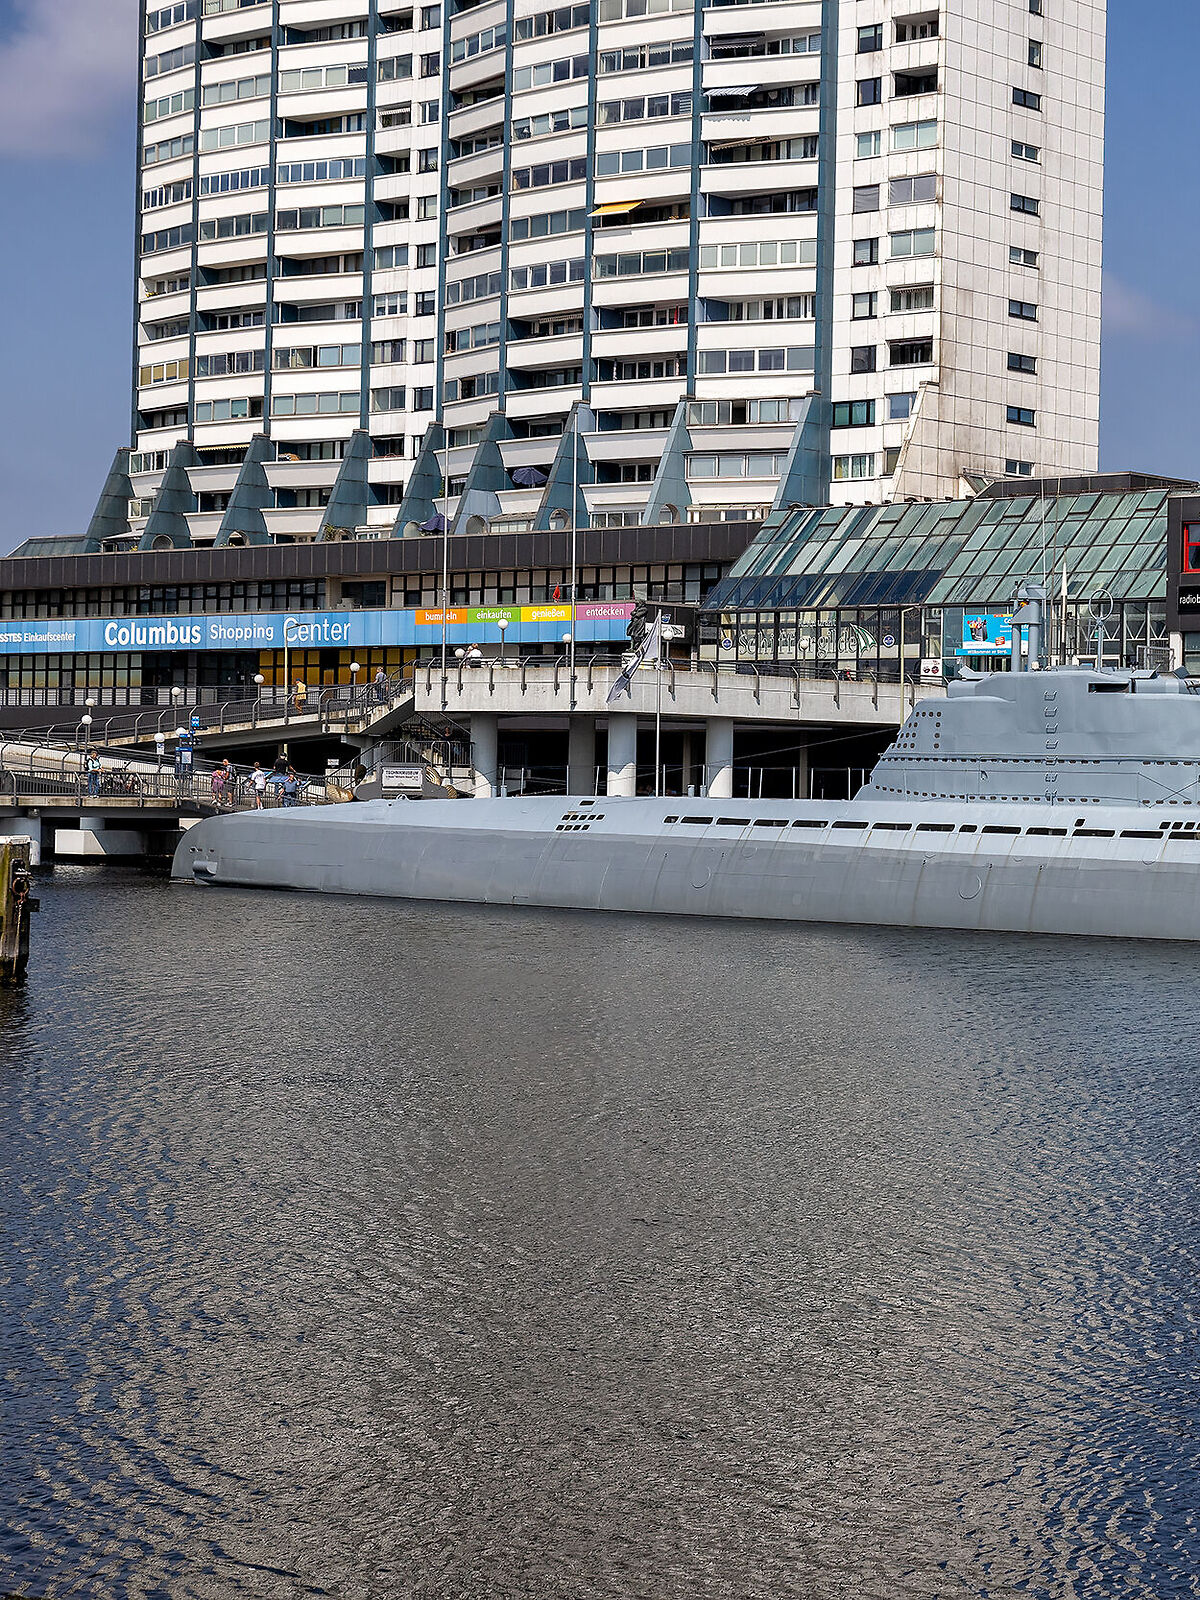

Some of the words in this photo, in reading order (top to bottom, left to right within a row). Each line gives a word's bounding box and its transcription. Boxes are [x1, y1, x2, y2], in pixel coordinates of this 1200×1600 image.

[476, 609, 512, 620] einkaufen
[531, 608, 566, 620] genießen
[585, 606, 625, 616] entdecken
[23, 631, 76, 642] Einkaufscenter
[104, 620, 202, 646] Columbus
[210, 623, 274, 642] Shopping
[283, 616, 352, 642] Center
